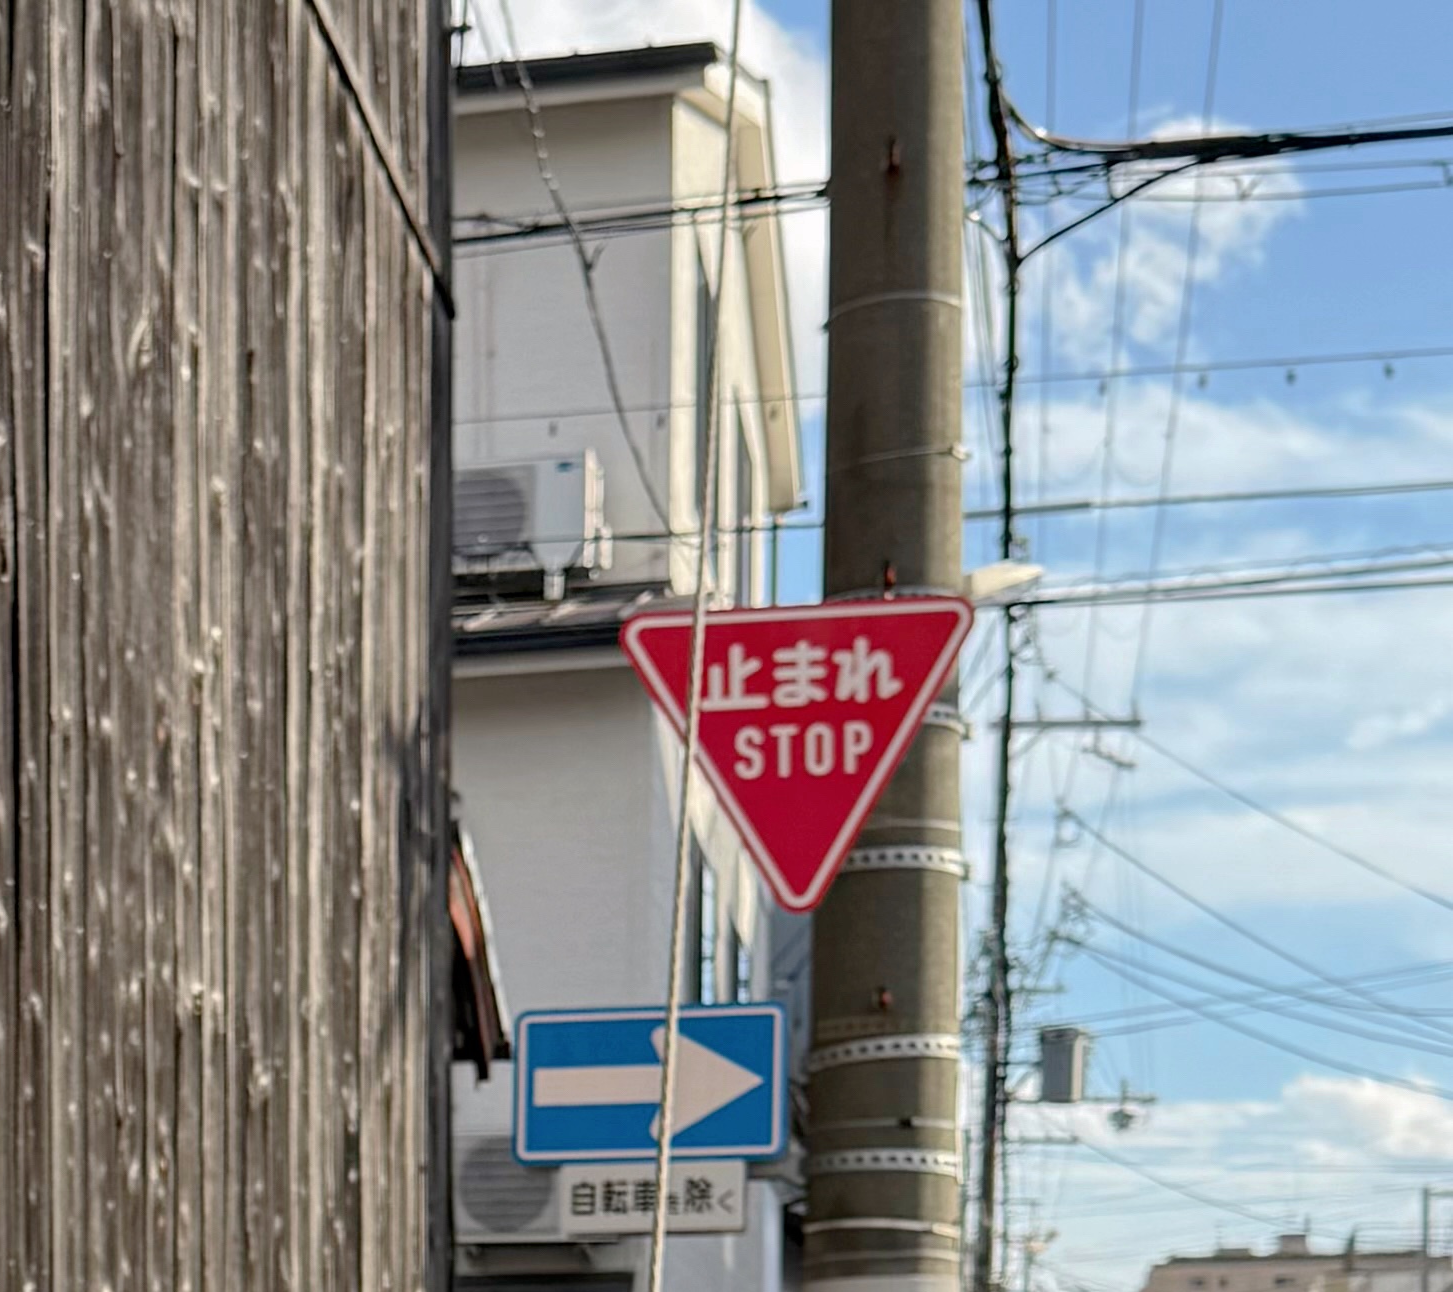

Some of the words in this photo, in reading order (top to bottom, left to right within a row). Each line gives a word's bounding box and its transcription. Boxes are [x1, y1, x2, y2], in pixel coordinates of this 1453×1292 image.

[698, 635, 903, 712] 止まれ
[733, 719, 874, 781] STOP
